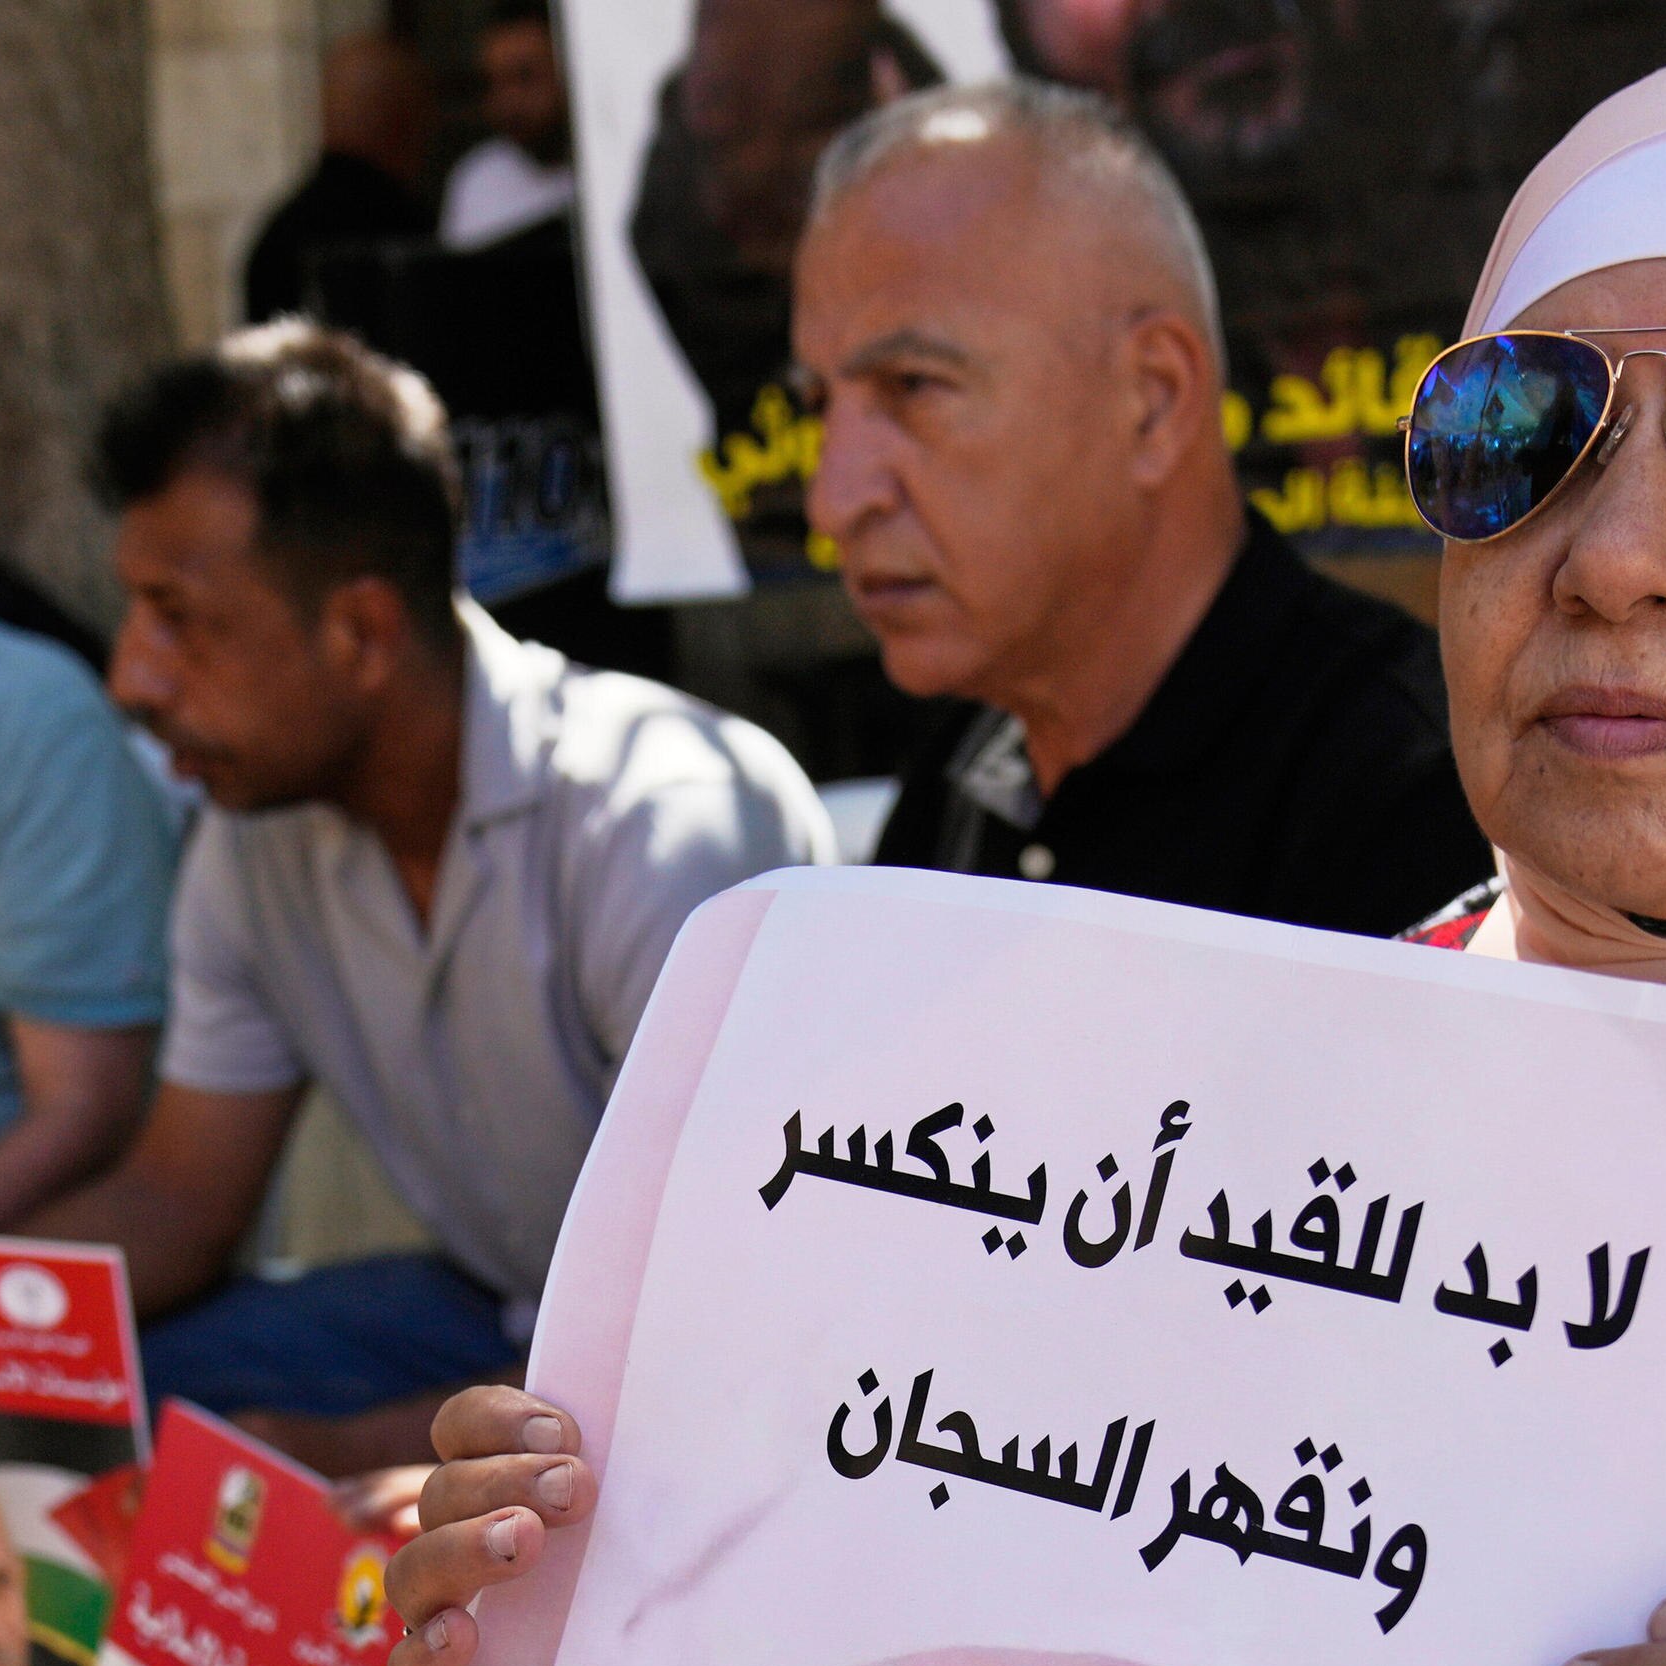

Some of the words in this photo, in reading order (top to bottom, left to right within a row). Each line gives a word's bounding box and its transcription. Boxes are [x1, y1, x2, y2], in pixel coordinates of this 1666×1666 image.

[758, 1103, 1046, 1260] ينكسر
[1063, 1100, 1192, 1268] أن
[1180, 1157, 1424, 1314] للقيد
[1434, 1243, 1537, 1367] بد
[1564, 1242, 1650, 1349] لا
[827, 1368, 1155, 1520] السجان
[1139, 1437, 1427, 1634] ونقهر
